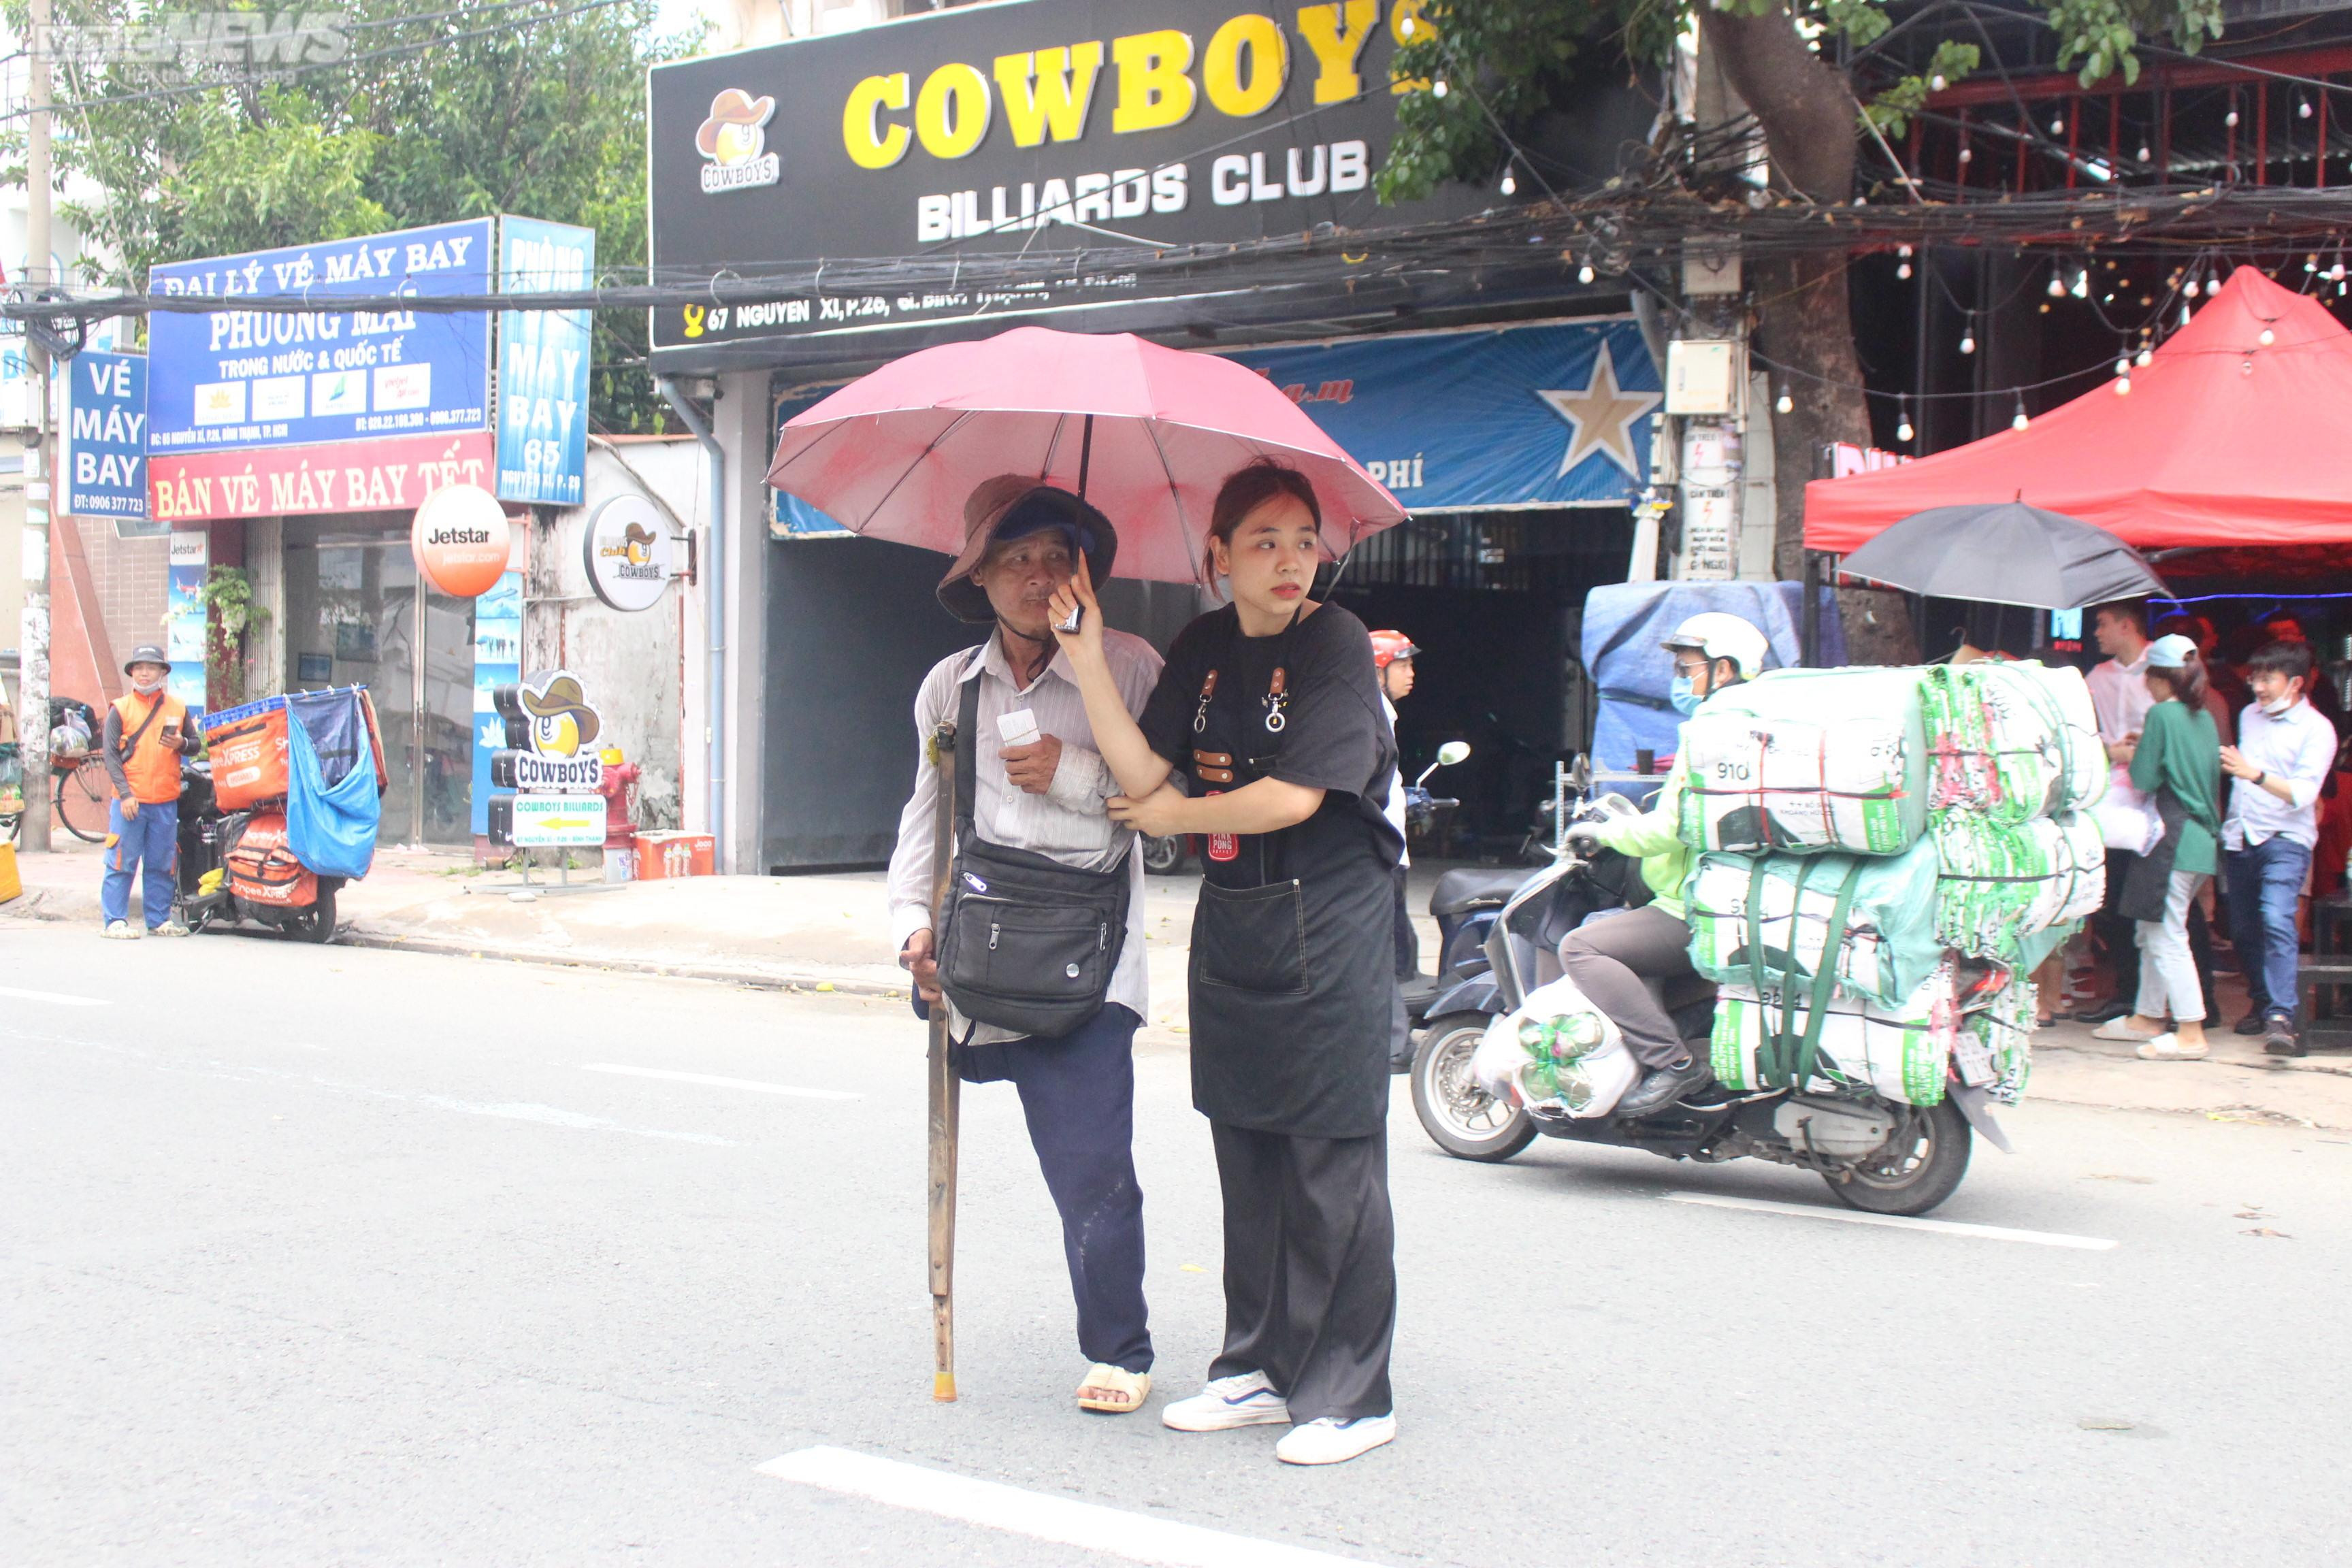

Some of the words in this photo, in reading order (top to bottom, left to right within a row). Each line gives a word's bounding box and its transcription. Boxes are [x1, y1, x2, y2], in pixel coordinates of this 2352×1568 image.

[703, 159, 772, 189] COWBOYS
[917, 163, 1188, 242] BILLIARDS
[1211, 140, 1371, 206] CLUB
[227, 259, 263, 295] LÝ
[273, 252, 315, 290] VÉ
[325, 244, 396, 283] MÁY
[406, 237, 472, 273] BAY
[708, 308, 728, 331] 67
[219, 357, 267, 378] TRONG
[273, 348, 314, 373] NƯỚC
[318, 352, 329, 370] &
[333, 340, 376, 371] QUỐC
[382, 335, 405, 363] TẾ
[89, 359, 131, 397] VÉ
[72, 404, 145, 444] MÁY
[508, 395, 578, 431] BAY
[273, 423, 288, 438] HCM
[524, 438, 560, 468] 65
[77, 452, 140, 488] BAY
[155, 468, 211, 517] BÁN
[220, 463, 260, 513] VÉ
[270, 459, 336, 512] MÁY
[345, 465, 408, 508] BAY
[418, 439, 484, 501] TẾT
[1368, 452, 1424, 489] PHÍ
[74, 495, 89, 508] ĐT:
[89, 495, 110, 510] 0906
[112, 497, 127, 511] 377
[129, 498, 144, 512] 723
[171, 544, 197, 555] Jetstar
[429, 527, 489, 544] Jetstar
[620, 565, 659, 578] COWBOYS
[519, 756, 598, 783] COWBOYS
[517, 802, 561, 812] COWBOYS
[564, 802, 604, 812] BILLIARDS
[1213, 840, 1232, 850] PONG
